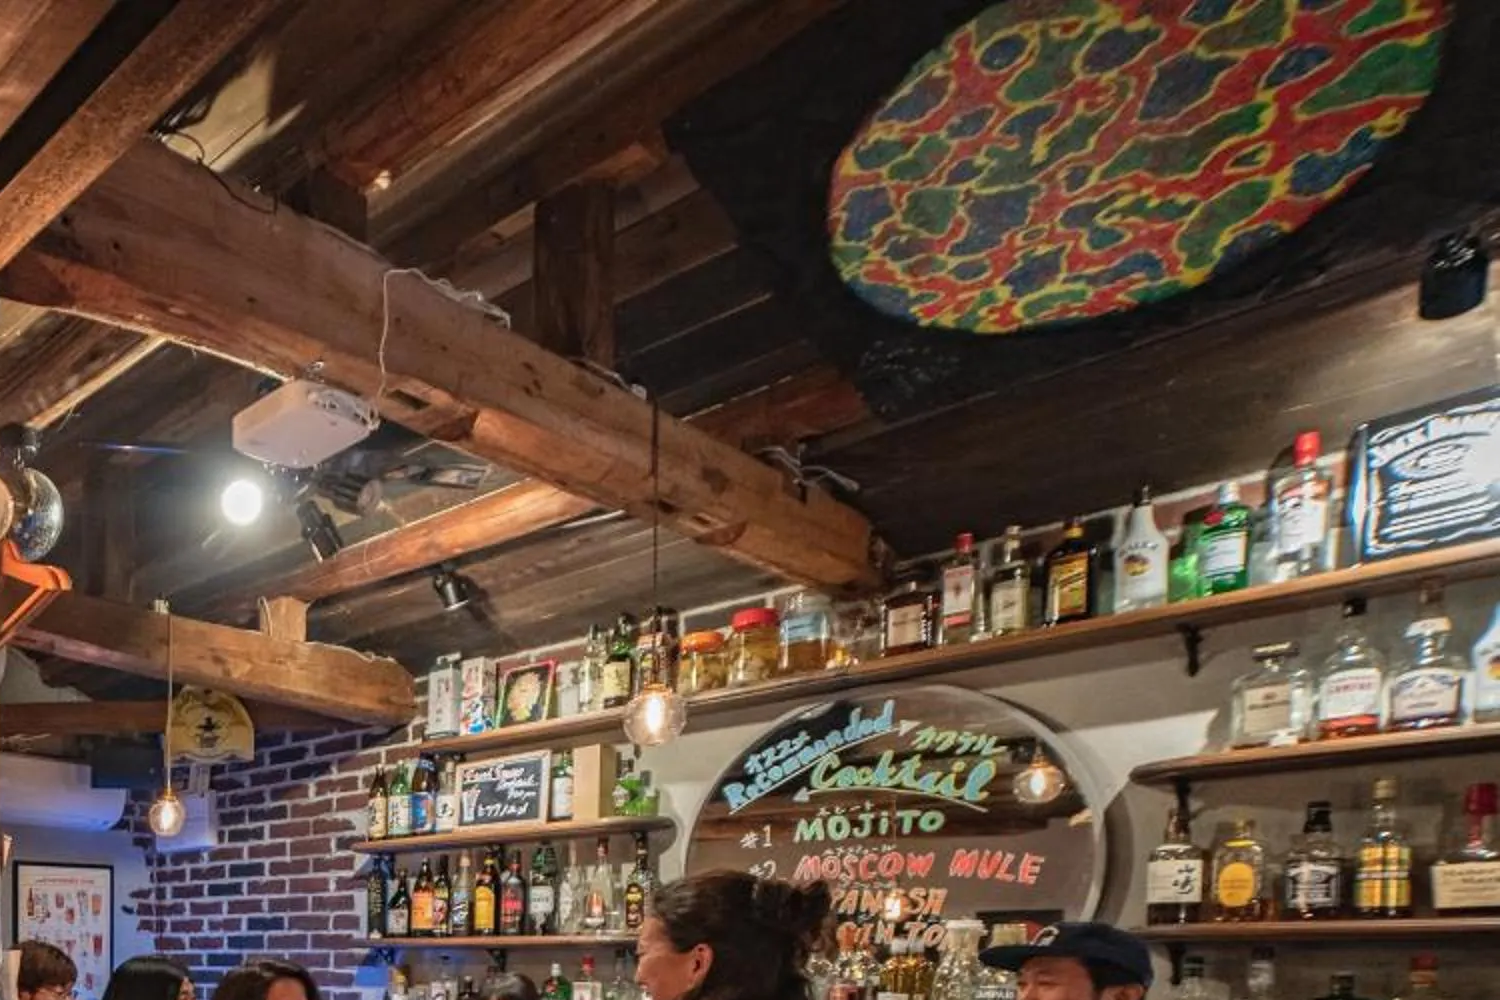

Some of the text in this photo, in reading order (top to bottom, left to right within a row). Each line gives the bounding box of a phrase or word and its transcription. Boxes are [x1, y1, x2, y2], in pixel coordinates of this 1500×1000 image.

[809, 750, 997, 801] Cocktail
[793, 851, 935, 882] MOSCOW
[949, 848, 1045, 885] MULE
